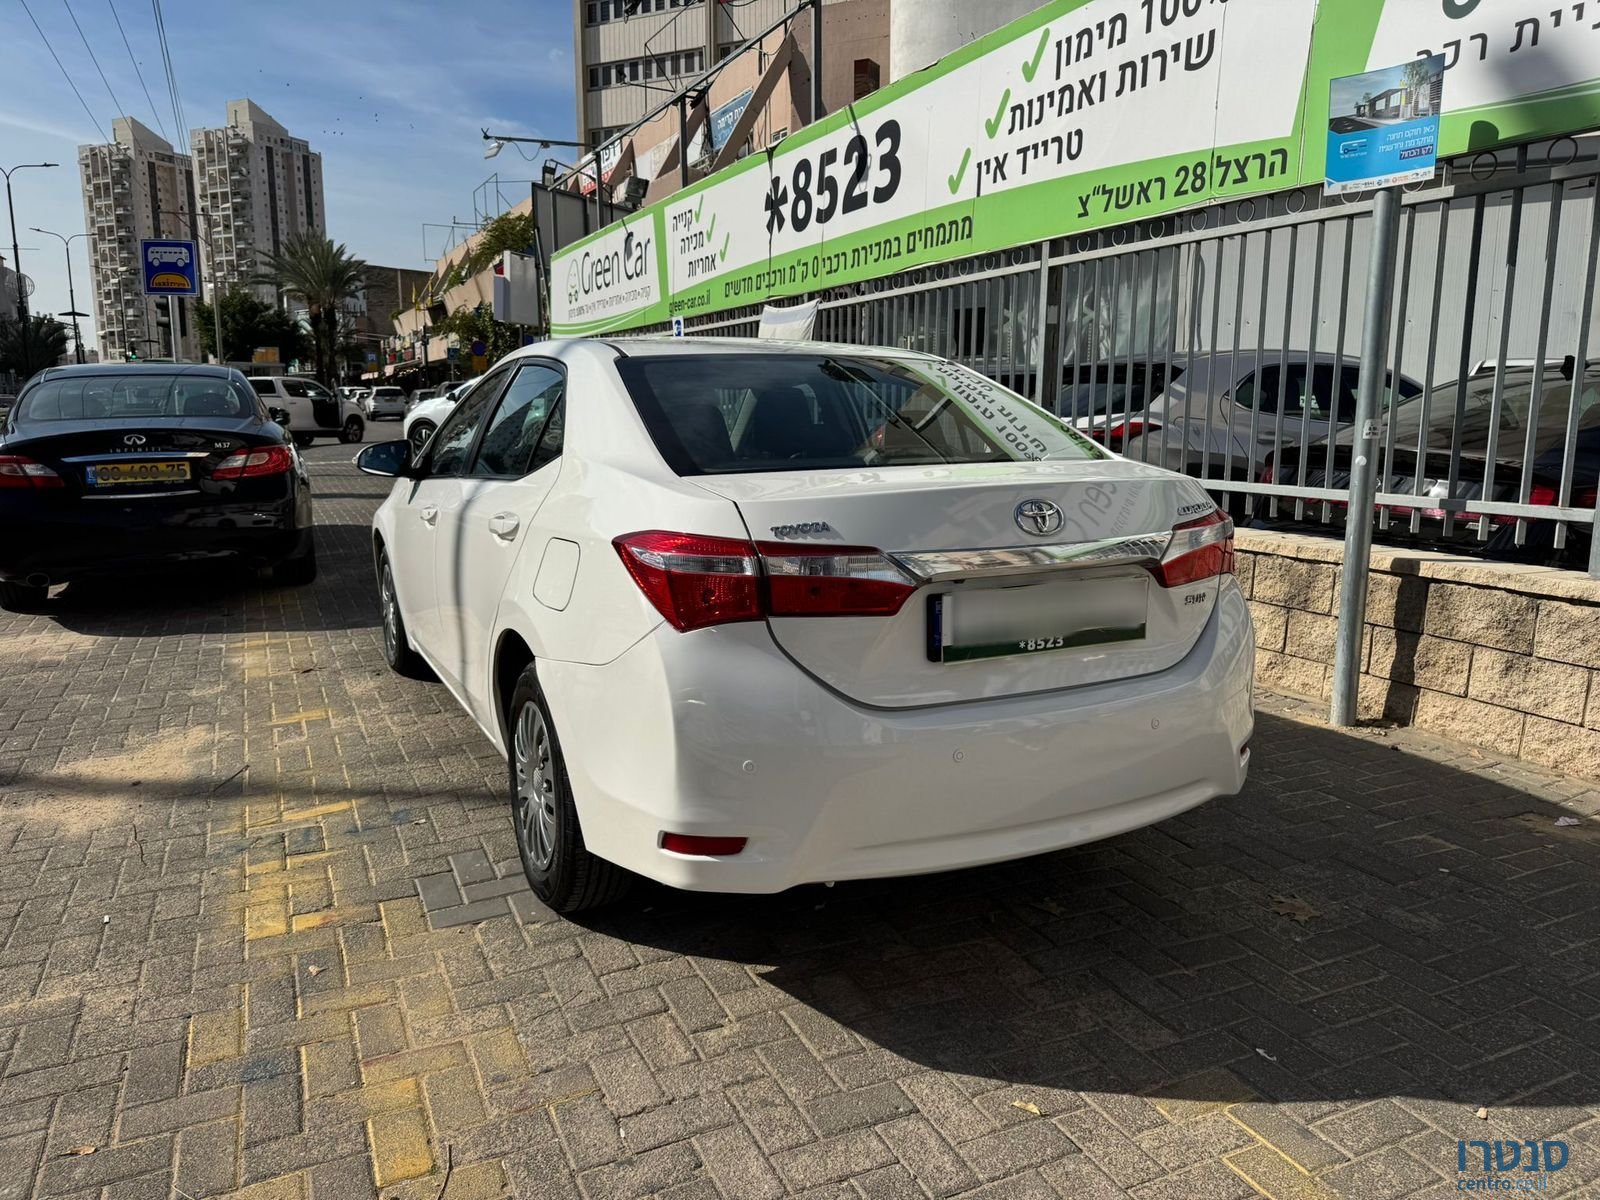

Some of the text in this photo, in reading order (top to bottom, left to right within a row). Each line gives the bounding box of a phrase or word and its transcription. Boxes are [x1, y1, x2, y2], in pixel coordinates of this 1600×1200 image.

[1055, 0, 1228, 80] 100 מימון
[1008, 28, 1216, 135] שירות ואמינות
[976, 128, 1083, 197] טרייד אין
[1215, 148, 1288, 187] הרצל
[1174, 161, 1206, 197] 28
[673, 209, 693, 232] קנייה
[906, 215, 973, 253] מתמחים
[681, 231, 704, 255] מכירה
[851, 236, 901, 269] במכירת
[582, 232, 651, 295] Green Car
[688, 253, 717, 278] אחריות
[812, 256, 819, 278] 0
[823, 251, 847, 275] רכבי
[724, 276, 753, 298] חדשים
[756, 267, 785, 291] ורכבים
[770, 521, 830, 538] TOYOTA
